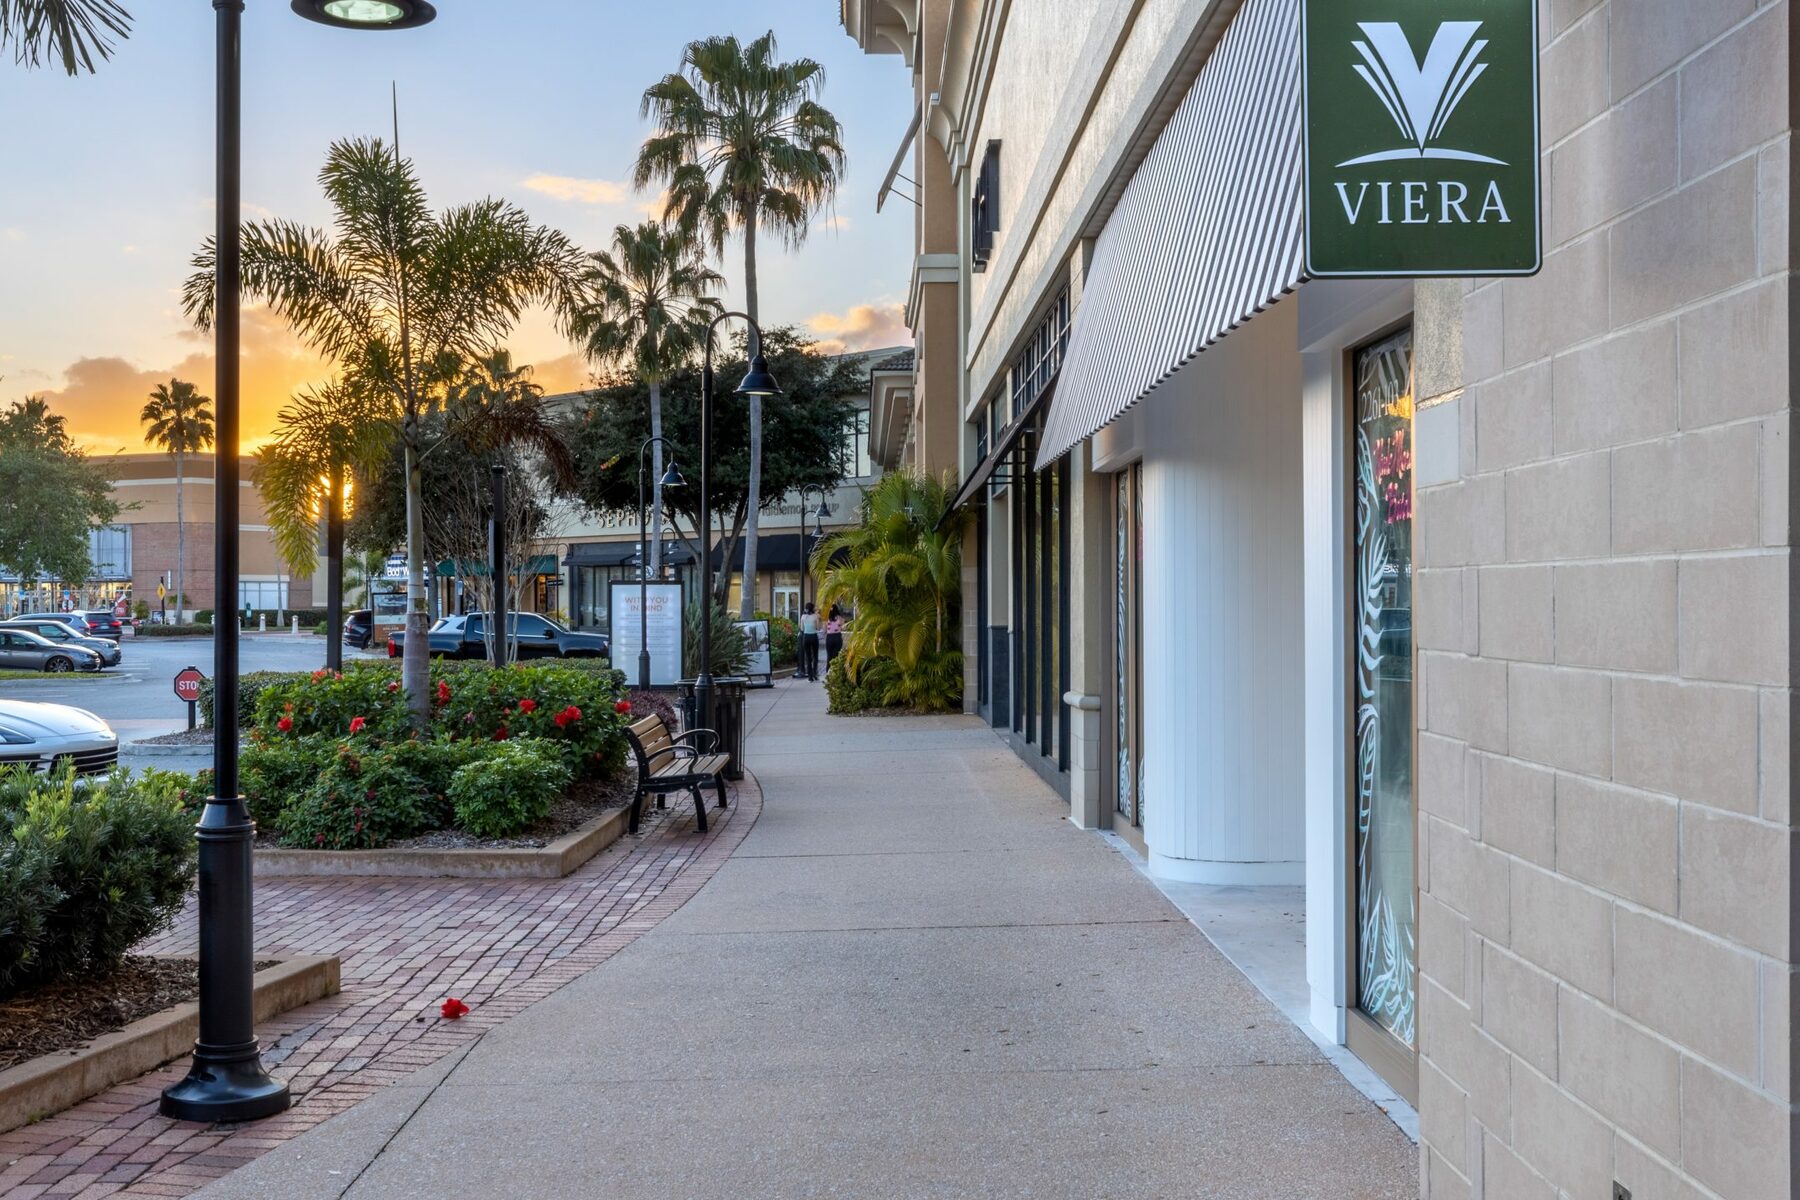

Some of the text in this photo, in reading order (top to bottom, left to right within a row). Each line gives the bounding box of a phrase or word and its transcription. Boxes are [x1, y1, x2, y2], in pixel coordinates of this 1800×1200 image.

[1334, 180, 1511, 224] VIERA
[1361, 379, 1400, 424] 2261-103
[624, 596, 669, 604] WIT YOU
[179, 680, 200, 690] STO
